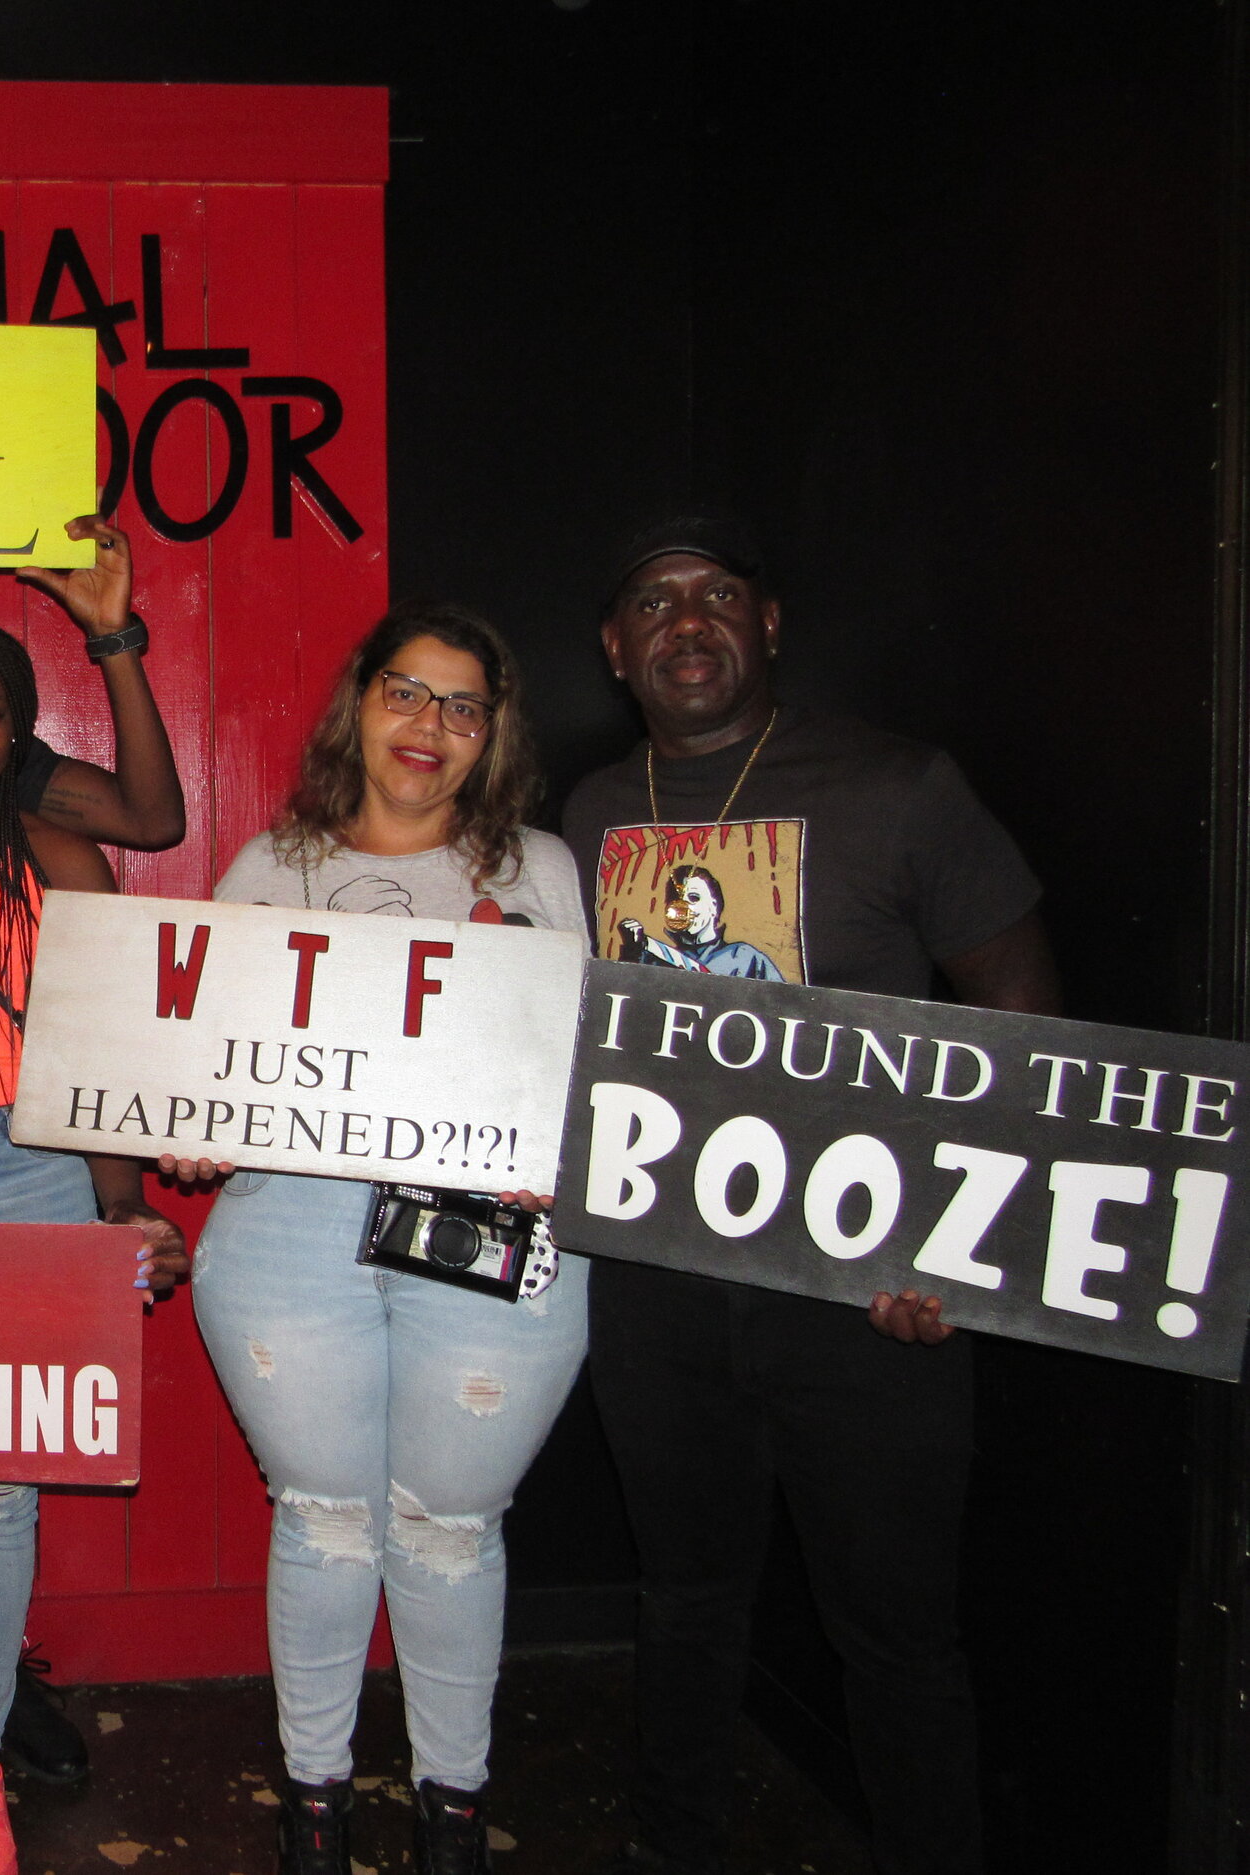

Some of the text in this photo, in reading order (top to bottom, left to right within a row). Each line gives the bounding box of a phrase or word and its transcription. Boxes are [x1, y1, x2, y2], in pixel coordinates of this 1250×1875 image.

[213, 1038, 369, 1092] JUST
[598, 992, 1238, 1143] I FOUND THE
[65, 1086, 518, 1173] HAPPENED?!?!
[585, 1081, 1229, 1339] BOOZE!
